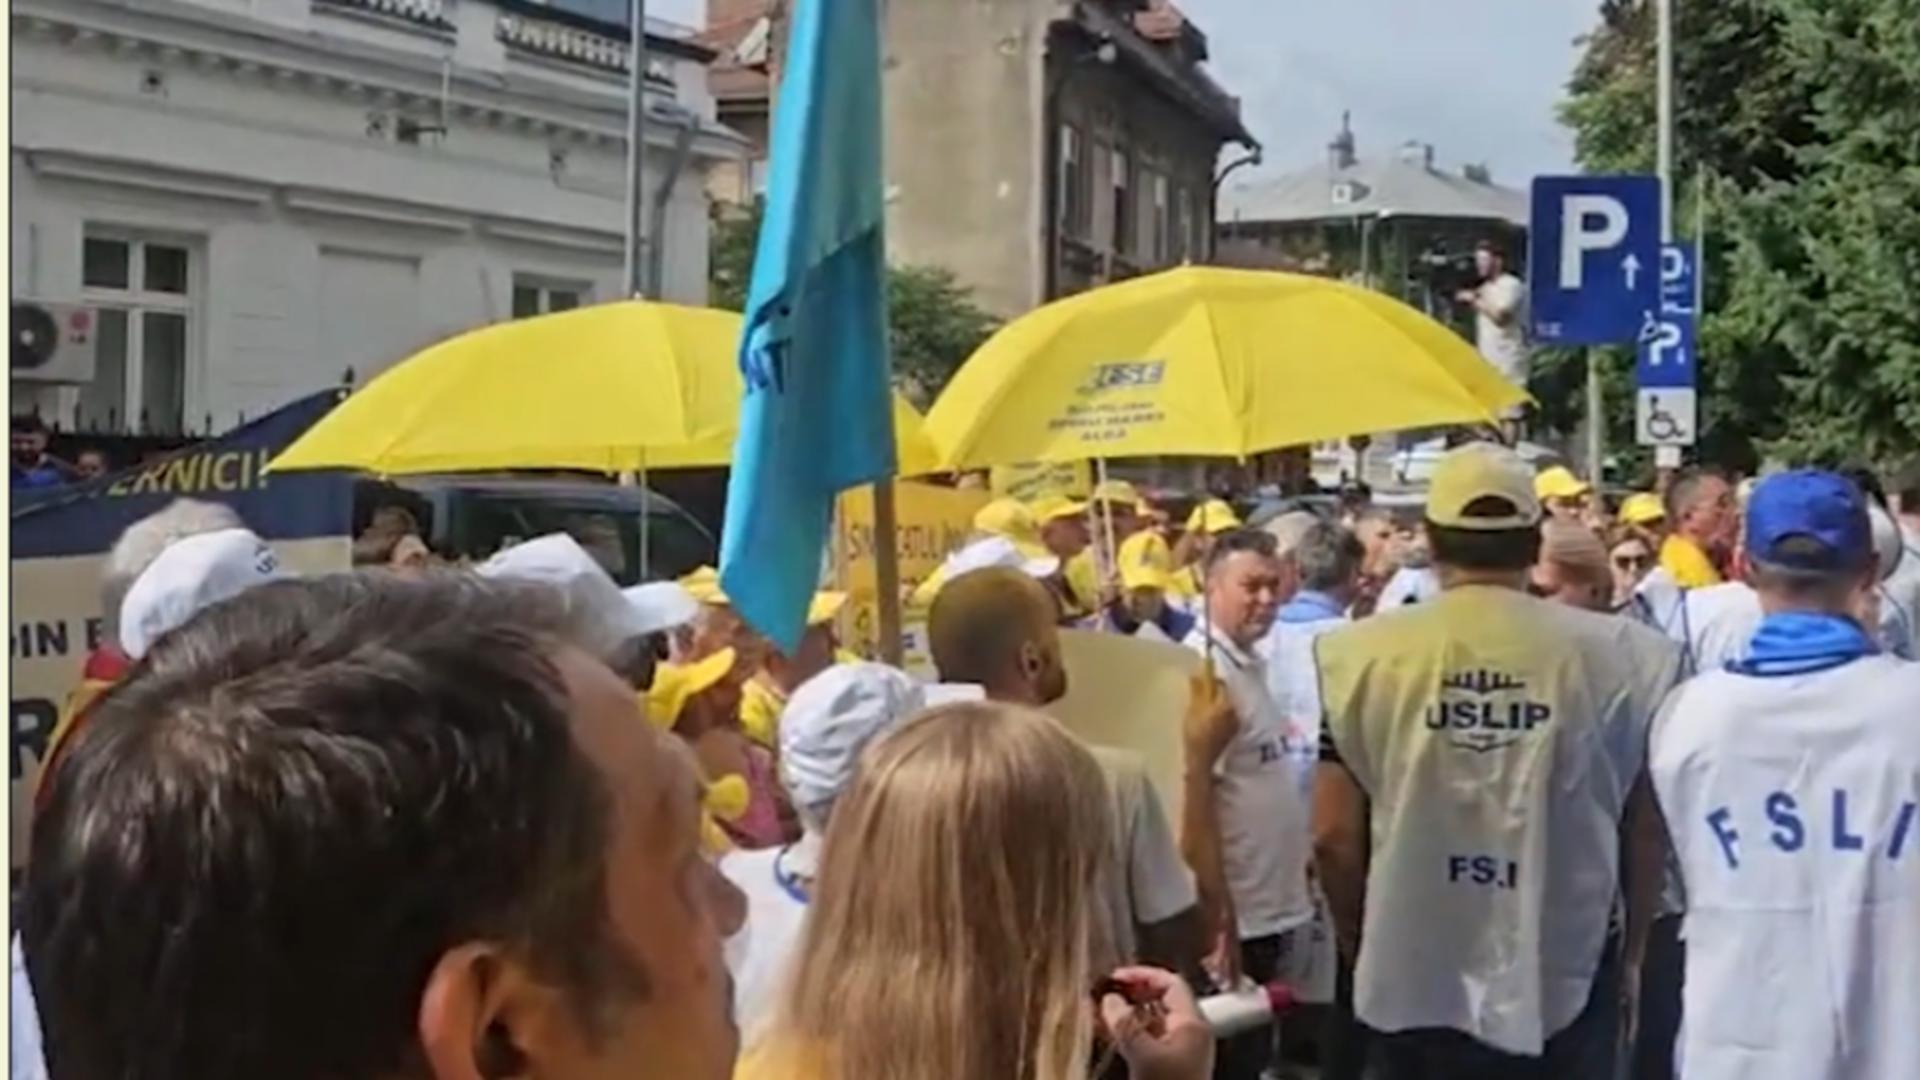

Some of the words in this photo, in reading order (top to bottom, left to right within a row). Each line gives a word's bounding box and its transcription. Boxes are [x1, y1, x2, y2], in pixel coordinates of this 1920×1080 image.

[1560, 194, 1628, 289] P
[11, 620, 69, 658] IN
[1426, 702, 1551, 730] USLIP
